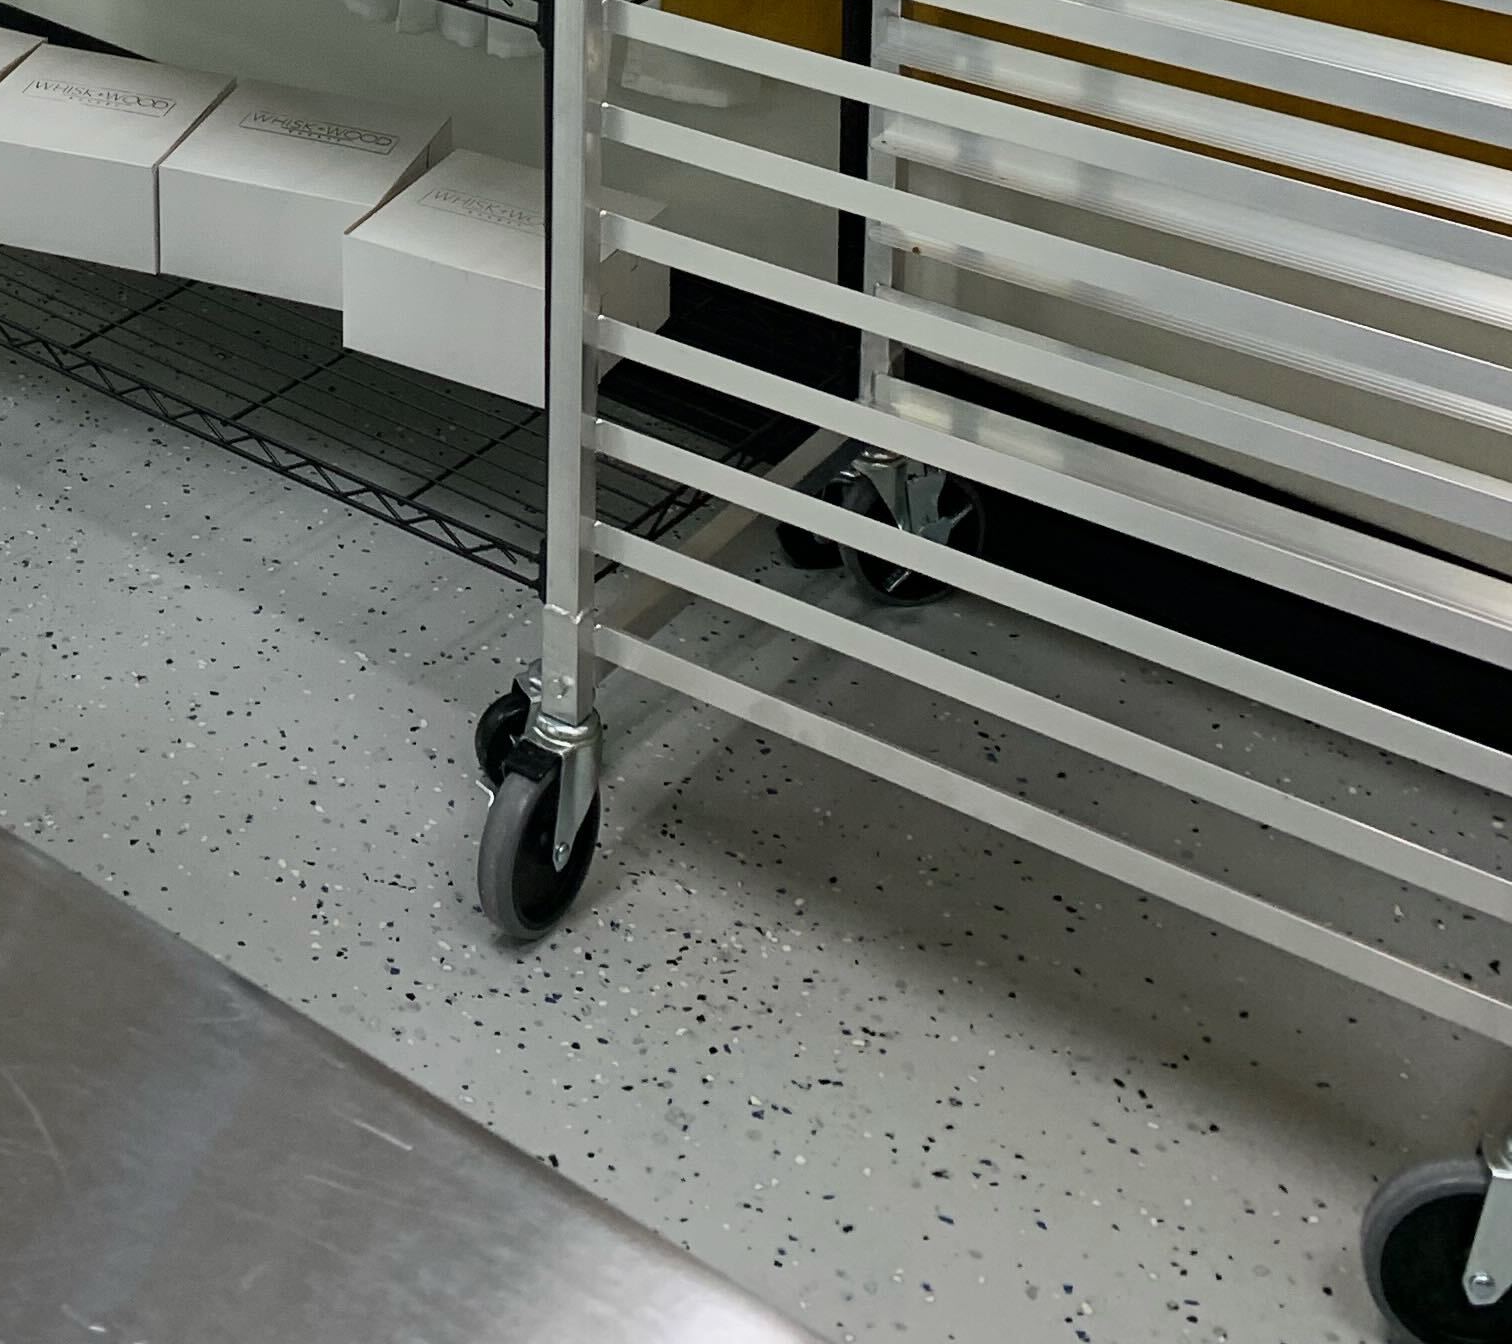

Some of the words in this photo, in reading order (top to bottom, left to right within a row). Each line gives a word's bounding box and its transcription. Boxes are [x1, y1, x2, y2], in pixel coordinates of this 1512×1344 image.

[106, 91, 169, 110] WOOD
[253, 111, 312, 130] WHISK
[326, 125, 393, 146] WOOD
